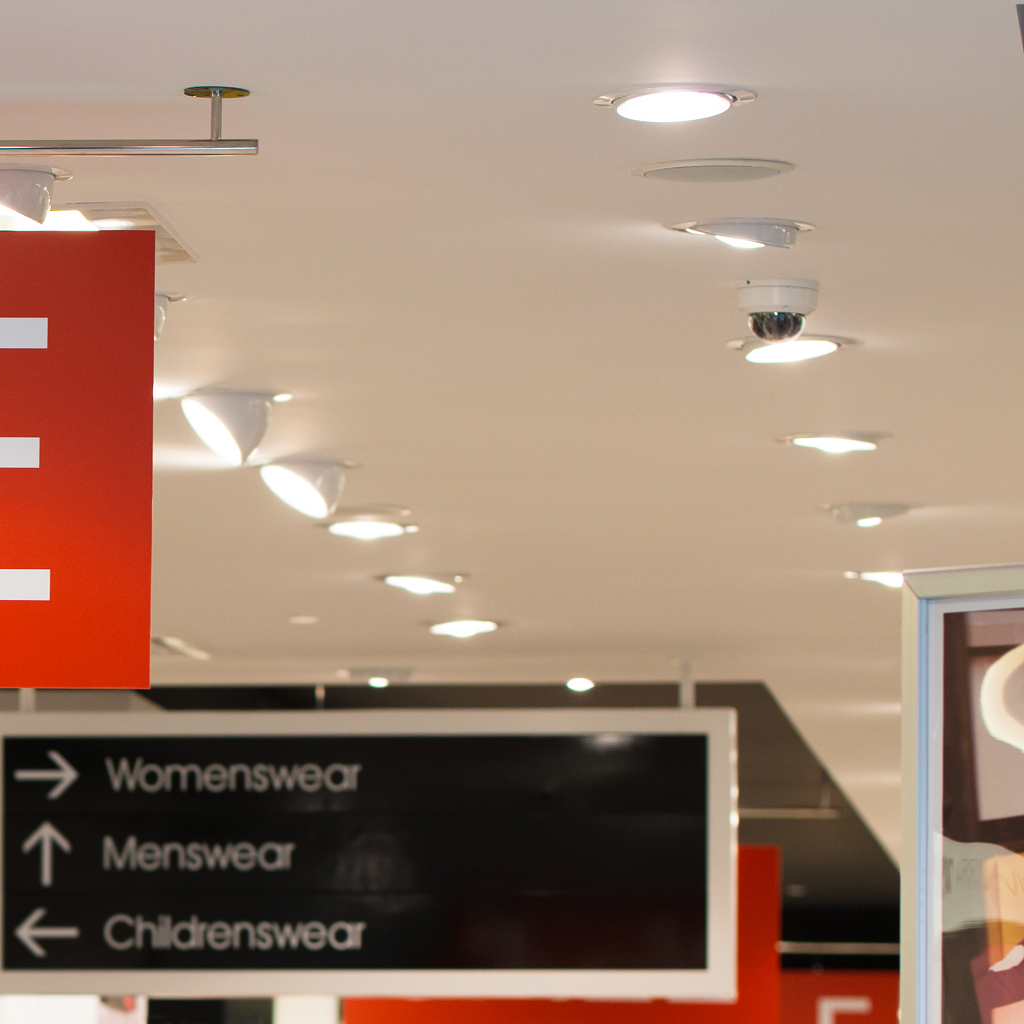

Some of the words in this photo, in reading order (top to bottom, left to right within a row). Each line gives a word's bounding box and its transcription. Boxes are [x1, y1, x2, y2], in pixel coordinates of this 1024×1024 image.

[104, 756, 362, 793] Womenswear
[102, 834, 296, 872] Menswear
[103, 913, 367, 951] Childrenswear
